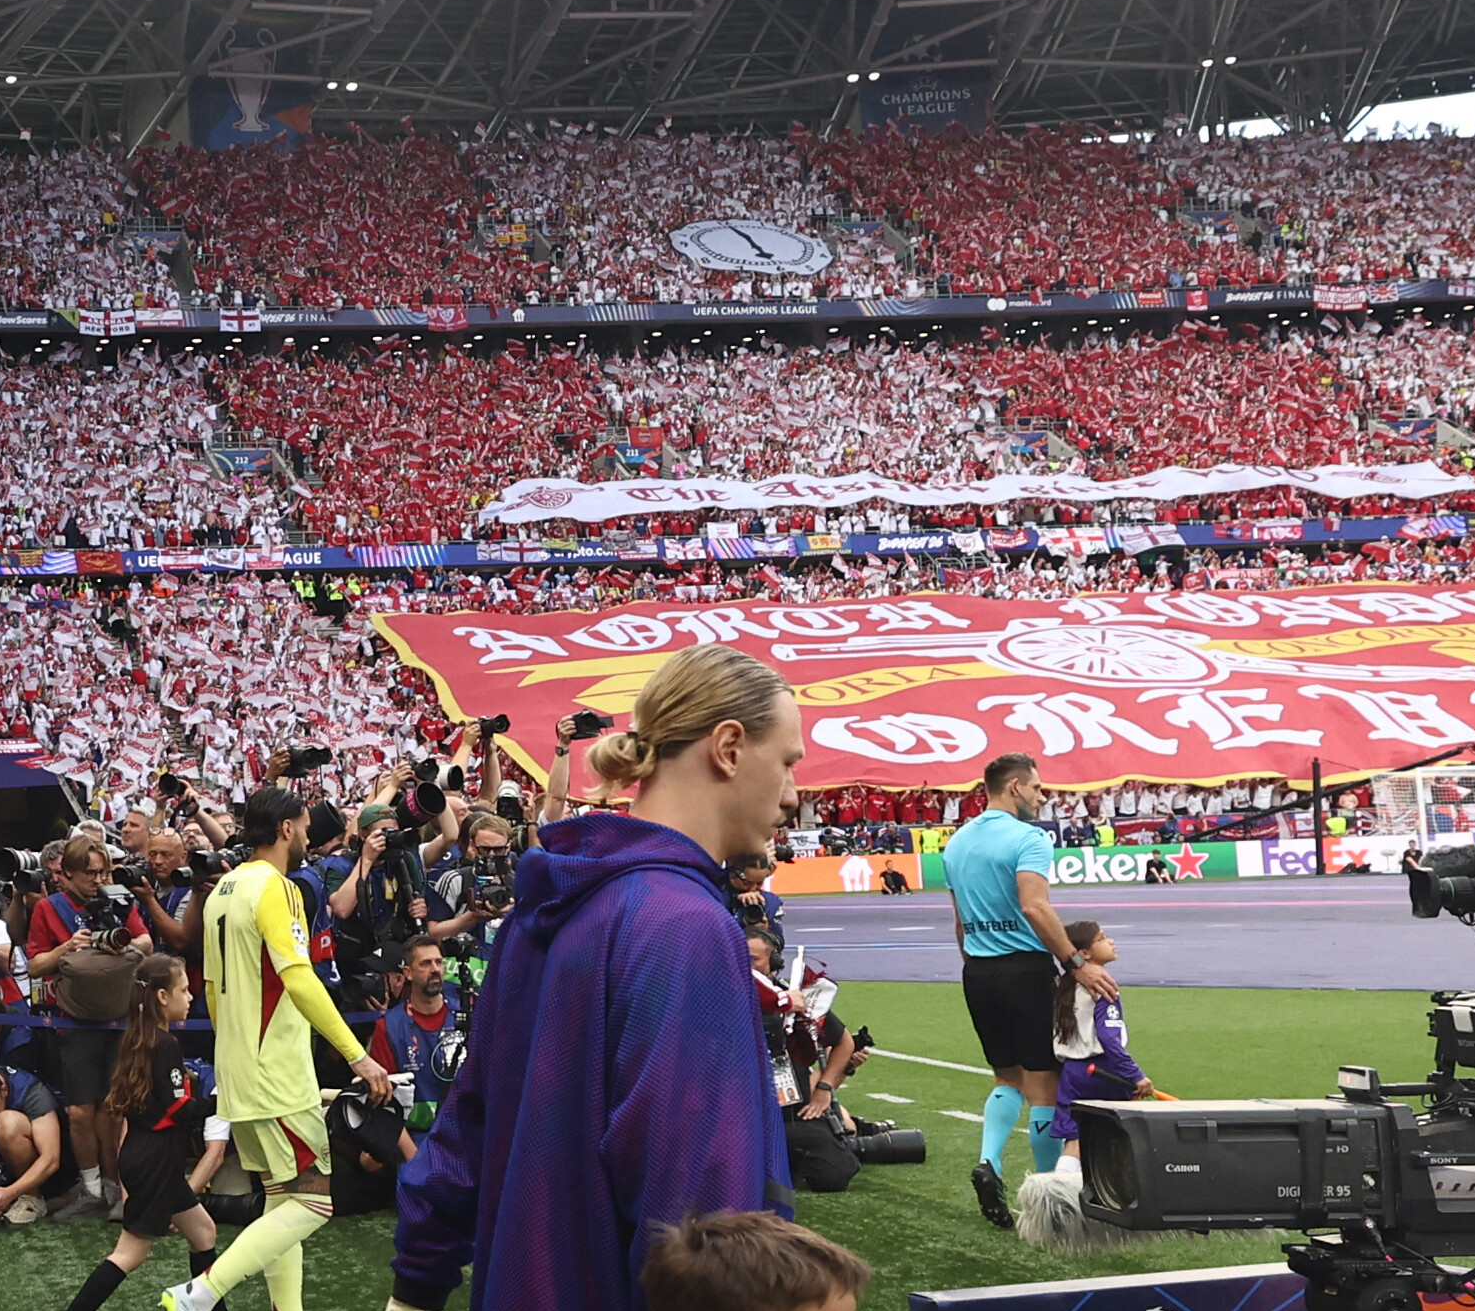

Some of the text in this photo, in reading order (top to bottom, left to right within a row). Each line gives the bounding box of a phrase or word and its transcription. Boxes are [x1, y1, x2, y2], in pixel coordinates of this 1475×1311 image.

[881, 88, 971, 105] CHAMPIONS
[898, 101, 957, 116] LEAGUE
[1276, 288, 1312, 300] FINAL
[693, 304, 818, 316] UEFA CHAMPIONS LEAGUE
[298, 313, 334, 323] FINAL
[625, 448, 639, 457] 211
[234, 456, 249, 465] 212
[625, 484, 732, 503] The
[137, 555, 161, 568] UE
[284, 552, 322, 565] AGUE
[454, 599, 972, 666] NORTH
[801, 664, 972, 704] ORIA
[217, 914, 227, 994] 1
[1431, 1157, 1458, 1165] SONY
[1165, 1163, 1200, 1173] Canon
[1336, 1185, 1351, 1197] 95
